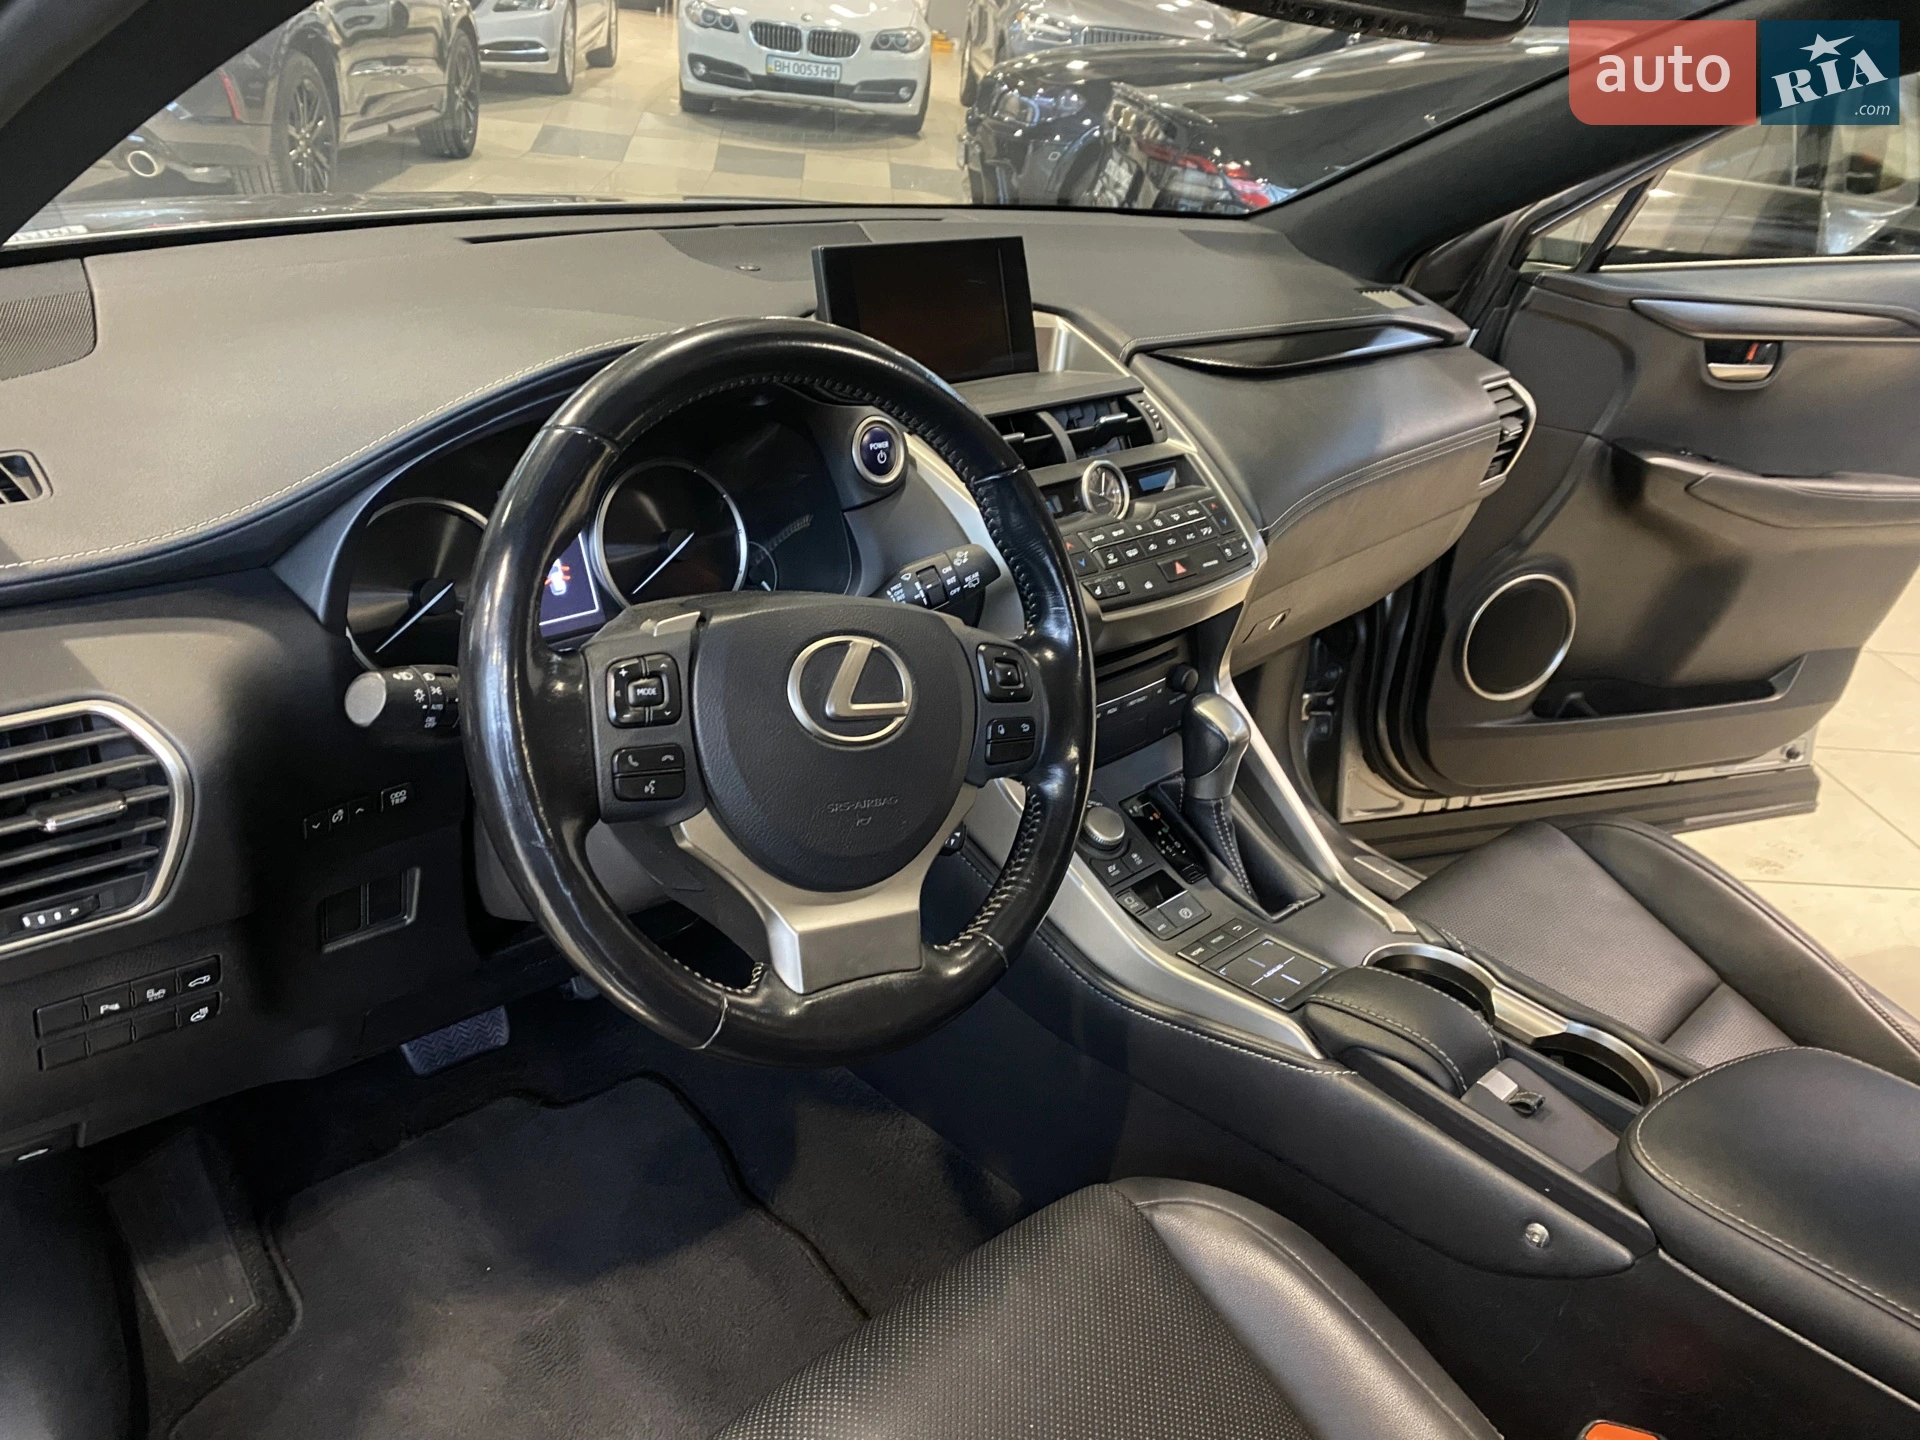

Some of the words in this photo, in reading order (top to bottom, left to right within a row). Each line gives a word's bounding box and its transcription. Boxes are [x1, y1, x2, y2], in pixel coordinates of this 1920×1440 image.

[792, 62, 820, 76] 0053
[869, 440, 889, 451] POWER
[636, 687, 658, 696] MODE
[390, 795, 408, 806] TRIP
